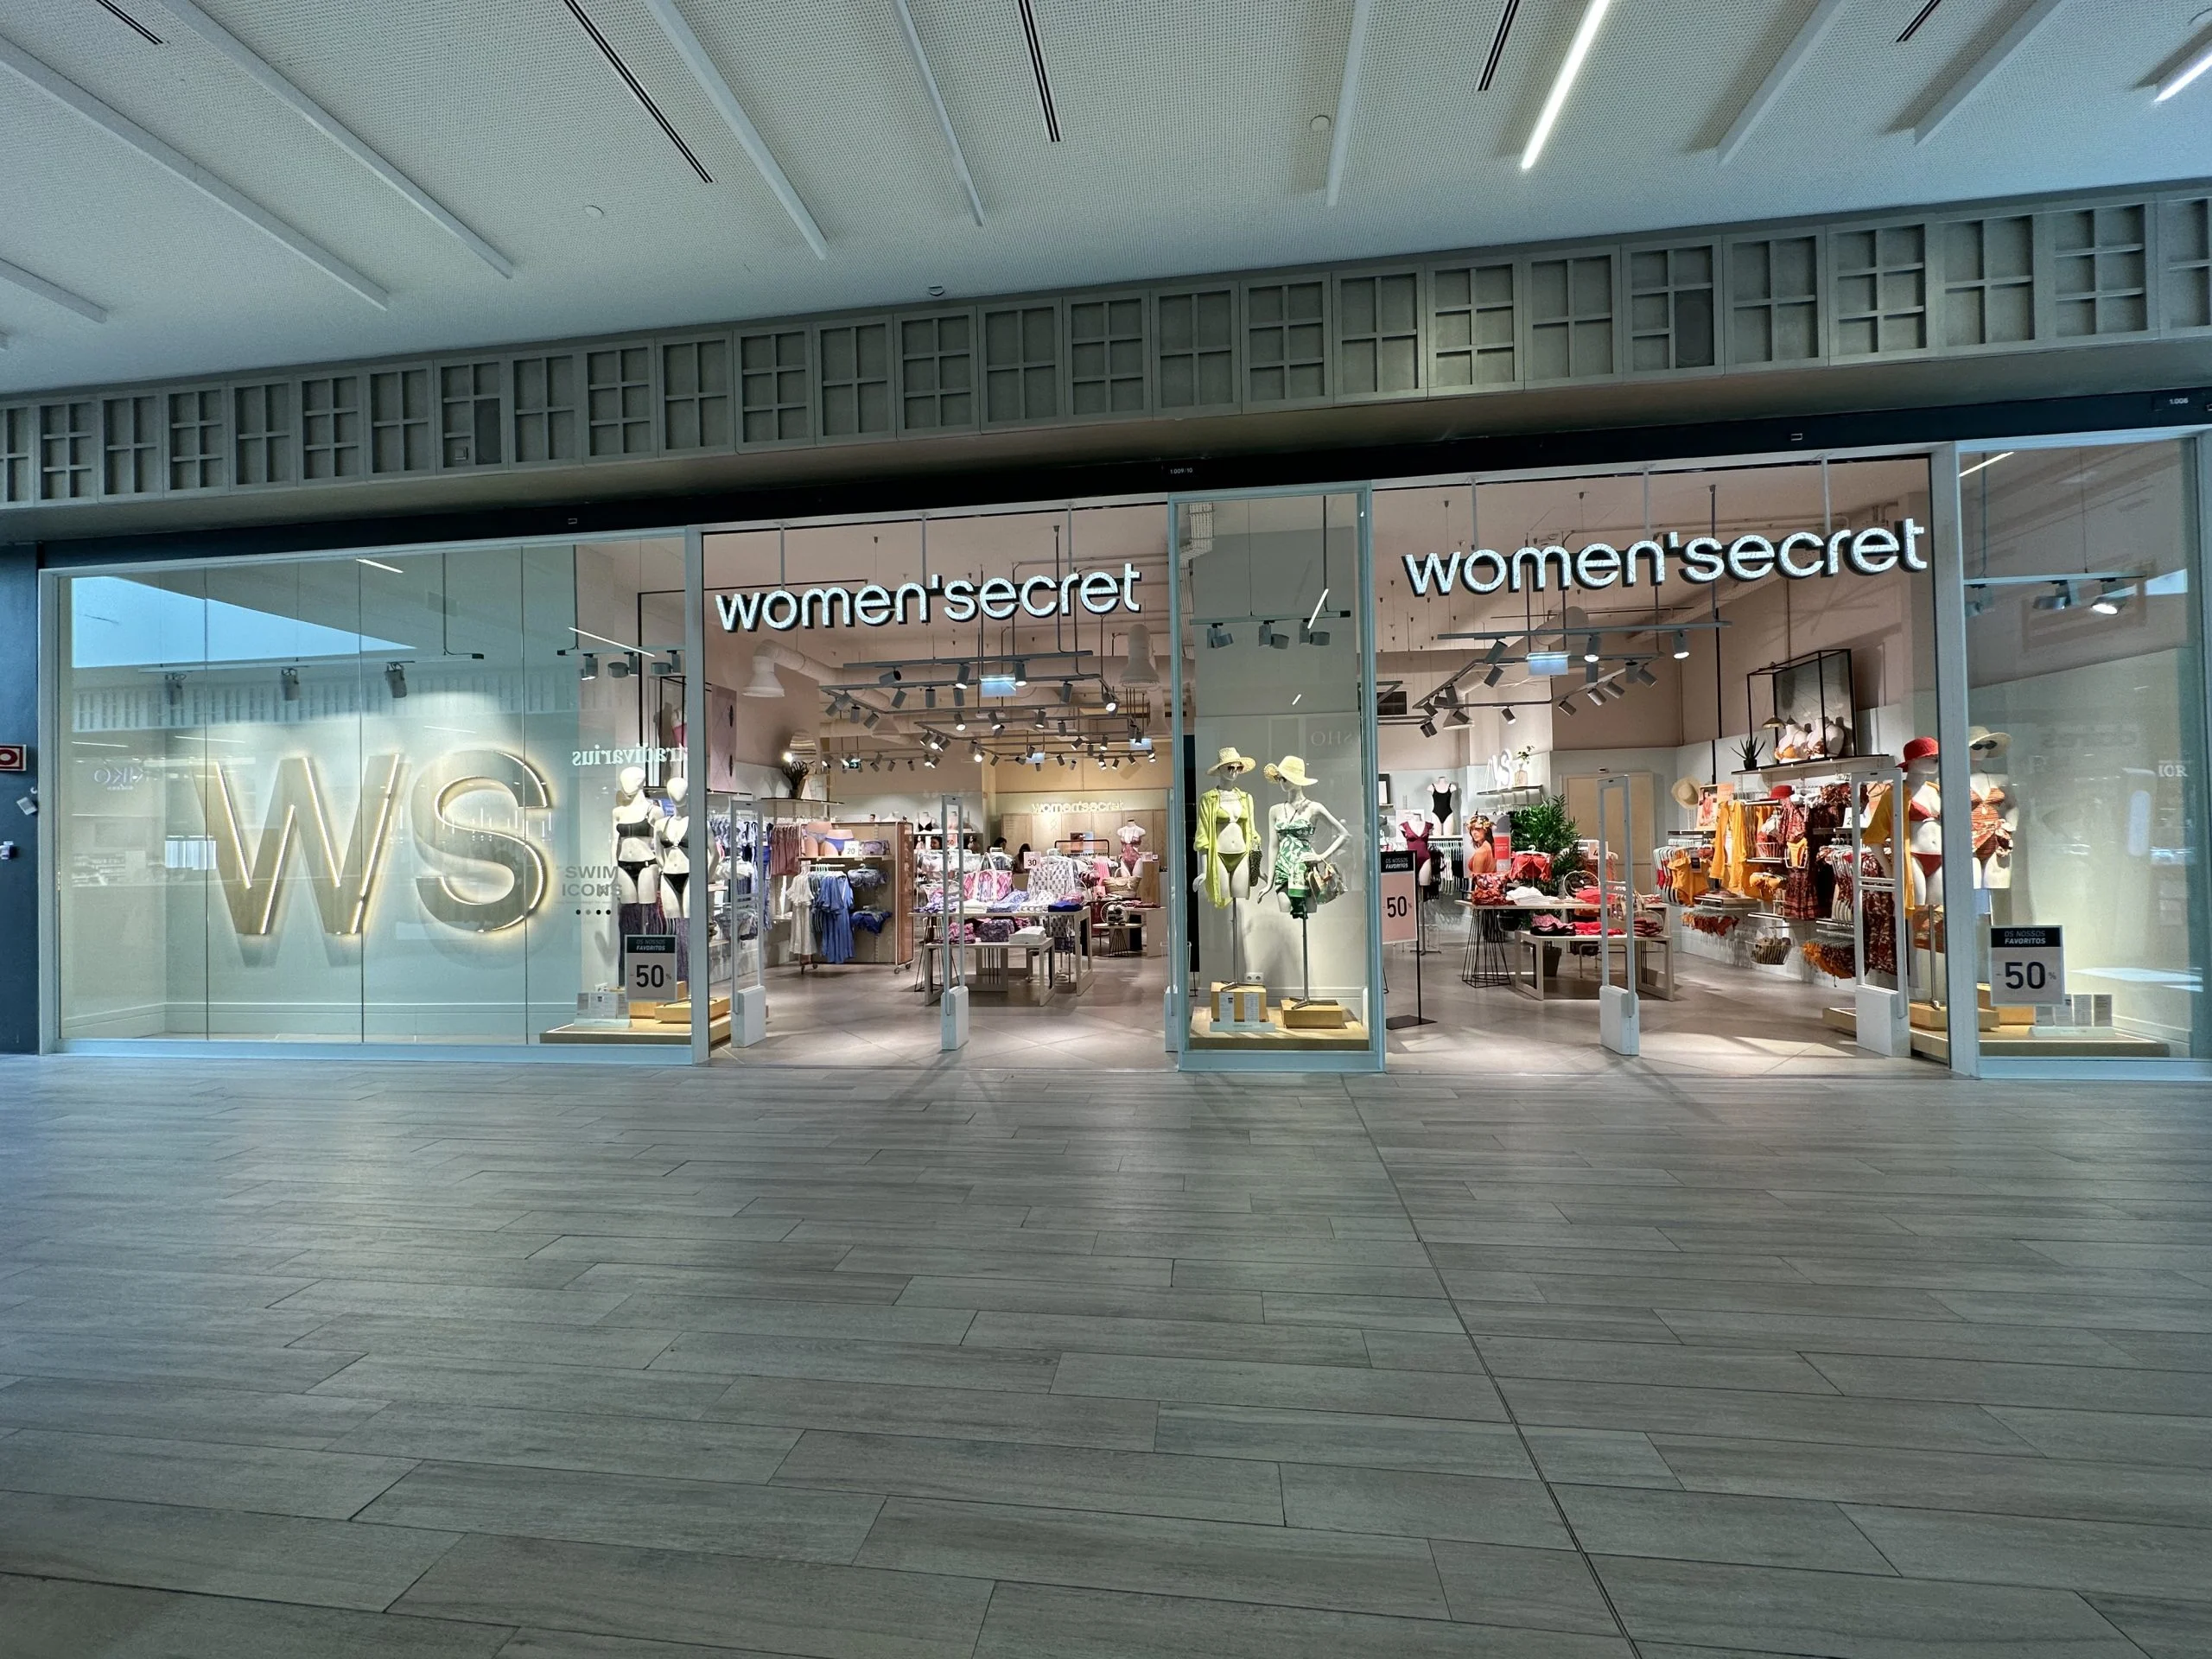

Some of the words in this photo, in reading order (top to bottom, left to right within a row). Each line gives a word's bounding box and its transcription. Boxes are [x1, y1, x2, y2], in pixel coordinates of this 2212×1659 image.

[1403, 518, 1929, 595] women'secret
[715, 563, 1141, 632] women'secret
[194, 749, 551, 935] WS
[565, 866, 619, 879] SWIM
[562, 883, 622, 897] ICONS
